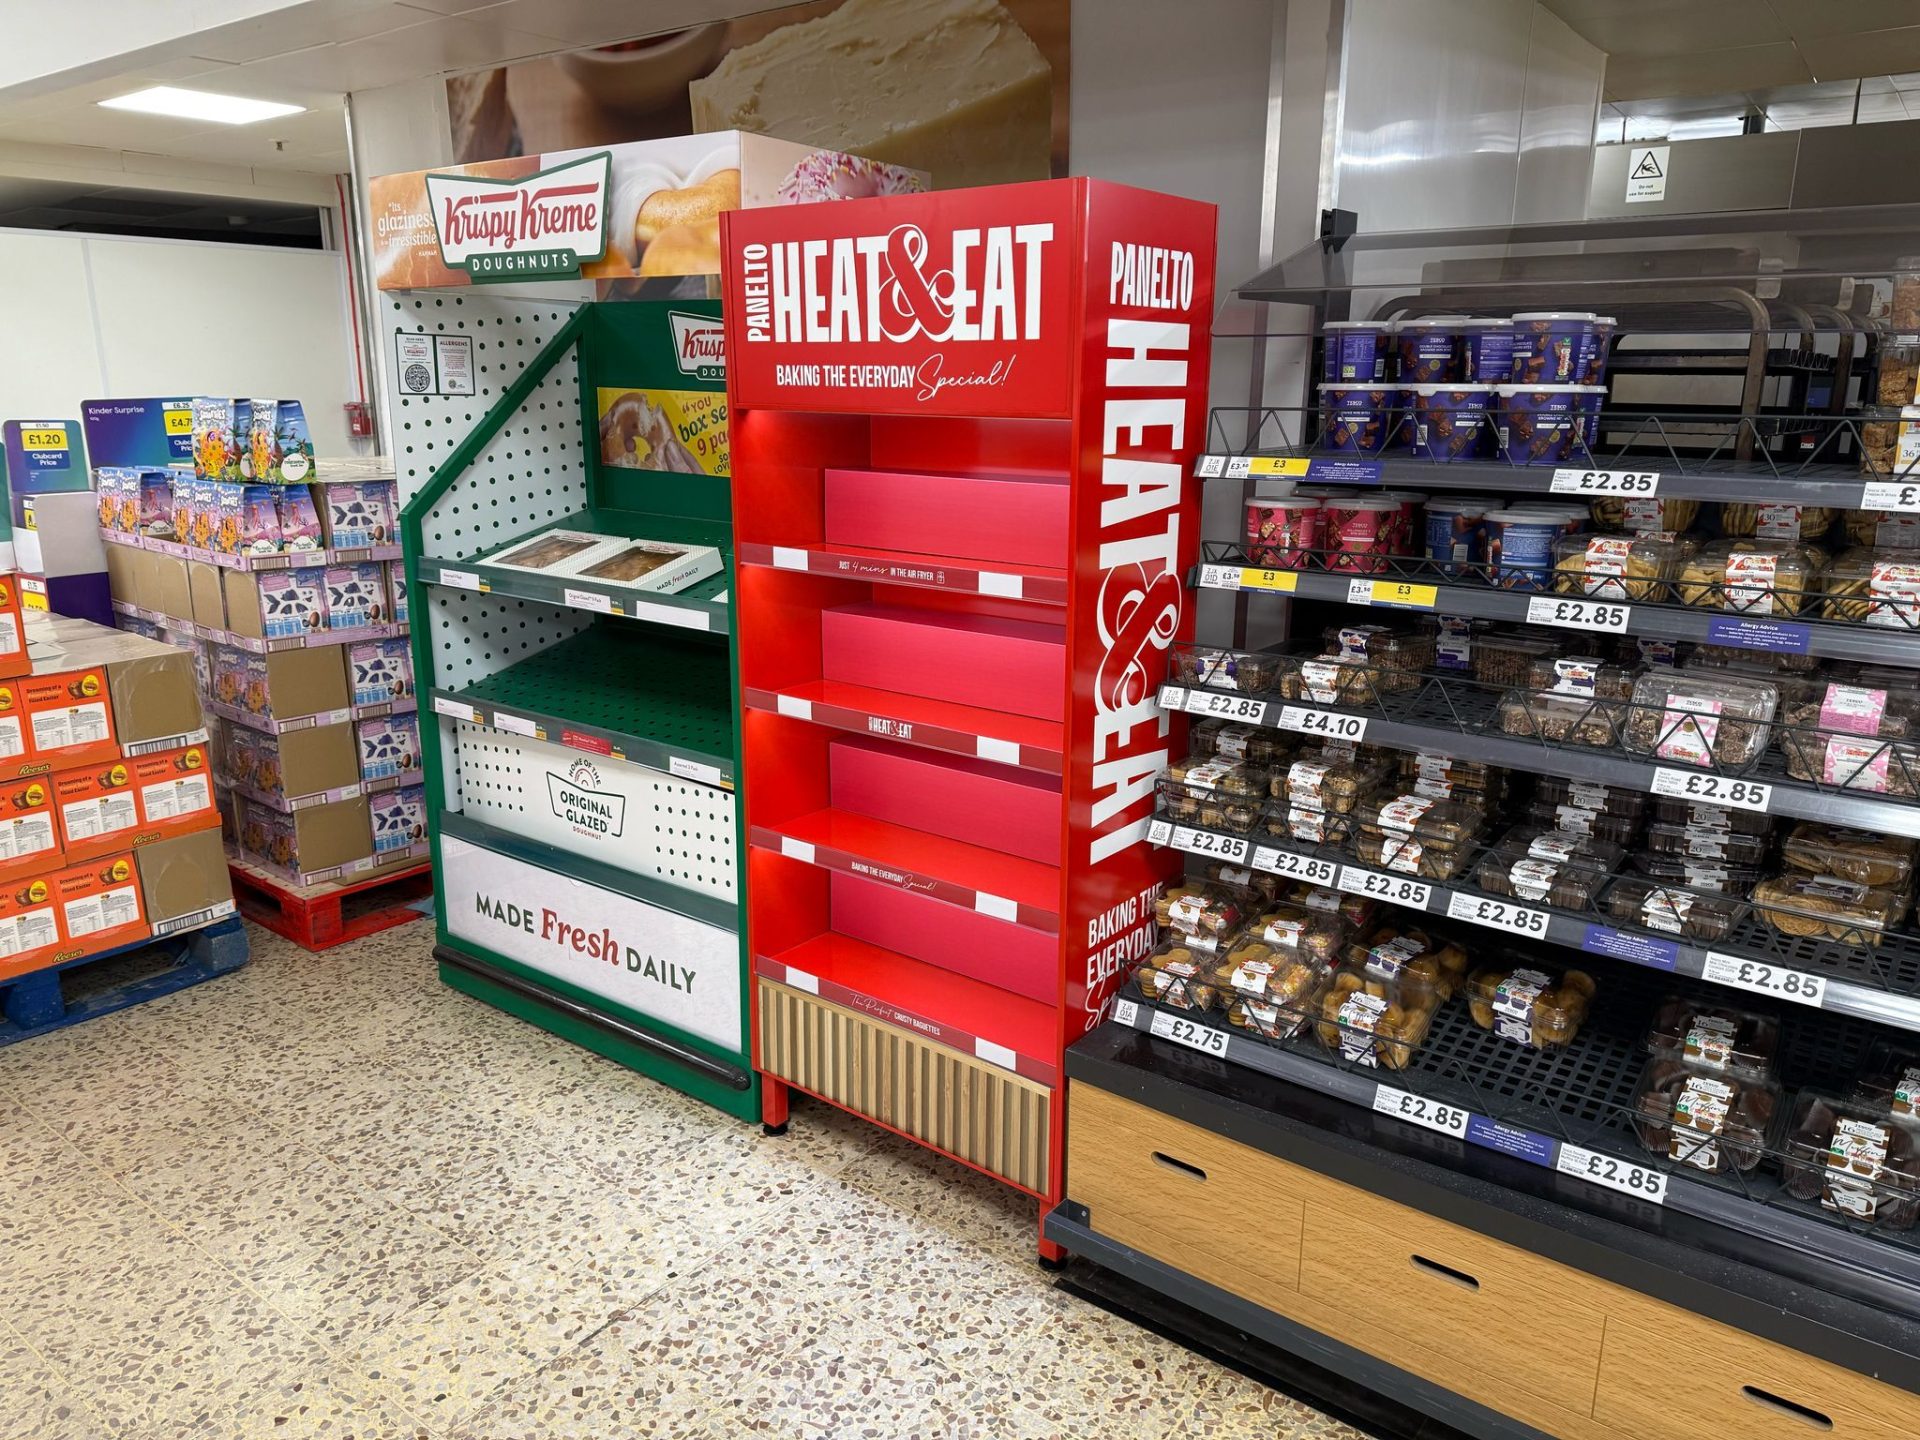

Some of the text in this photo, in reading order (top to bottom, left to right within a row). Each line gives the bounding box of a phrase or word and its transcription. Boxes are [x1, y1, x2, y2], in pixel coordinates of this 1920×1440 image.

[445, 182, 599, 249] Krispy Kreme
[472, 253, 569, 271] DOUGHNUTS
[1110, 241, 1194, 311] PANELTO
[744, 243, 771, 342] PANELTO
[776, 353, 1018, 402] BAKING THE EVERYDAY Special!
[88, 406, 145, 415] Kinder Surprise
[29, 434, 60, 445] £1.20
[678, 414, 708, 442] box
[697, 438, 706, 456] 9
[1902, 450, 1915, 458] 36
[1274, 460, 1286, 468] £3
[1580, 472, 1653, 491] £2.85
[1765, 513, 1776, 521] 30
[656, 567, 699, 591] MADE fresh DAILY
[839, 561, 934, 581] JUST 4 mins IN THE AIR FRYER
[1264, 572, 1275, 581] £3
[1398, 585, 1411, 595] £3
[1555, 602, 1624, 627] £2.85
[1741, 622, 1759, 630] Allergy
[1208, 696, 1262, 719] £2.85
[1302, 712, 1361, 737] £4.10
[568, 758, 601, 785] HOME OF THE
[1575, 796, 1586, 805] 20
[1685, 775, 1765, 805] £2.85
[560, 790, 612, 819] ORIGINAL
[1696, 812, 1707, 821] 20
[566, 809, 608, 833] GLAZED
[573, 826, 601, 840] DOUGHNUT
[1192, 832, 1245, 857] £2.85
[851, 862, 869, 874] BAKING
[869, 866, 878, 877] THE
[878, 870, 903, 883] EVERYDAY
[1274, 854, 1332, 880] £2.85
[1364, 874, 1426, 904] £2.85
[1088, 896, 1137, 950] BAKING
[1476, 901, 1545, 932] £2.85
[476, 891, 697, 994] MADE Fresh DAILY
[1087, 919, 1160, 990] EVERYDAY
[1738, 962, 1818, 998] £2.85
[1120, 1010, 1133, 1019] 01A
[1122, 1002, 1133, 1011] ZJX
[894, 1011, 912, 1025] CRUSTY
[912, 1018, 941, 1036] BAGUETTES
[1172, 1020, 1224, 1051] £2.75
[1342, 1033, 1353, 1043] 16
[1692, 1082, 1703, 1090] 16
[1399, 1096, 1464, 1130] £2.85
[1494, 1124, 1527, 1139] Allergy Advice
[1842, 1124, 1856, 1133] 16
[1587, 1154, 1661, 1195] £2.85
